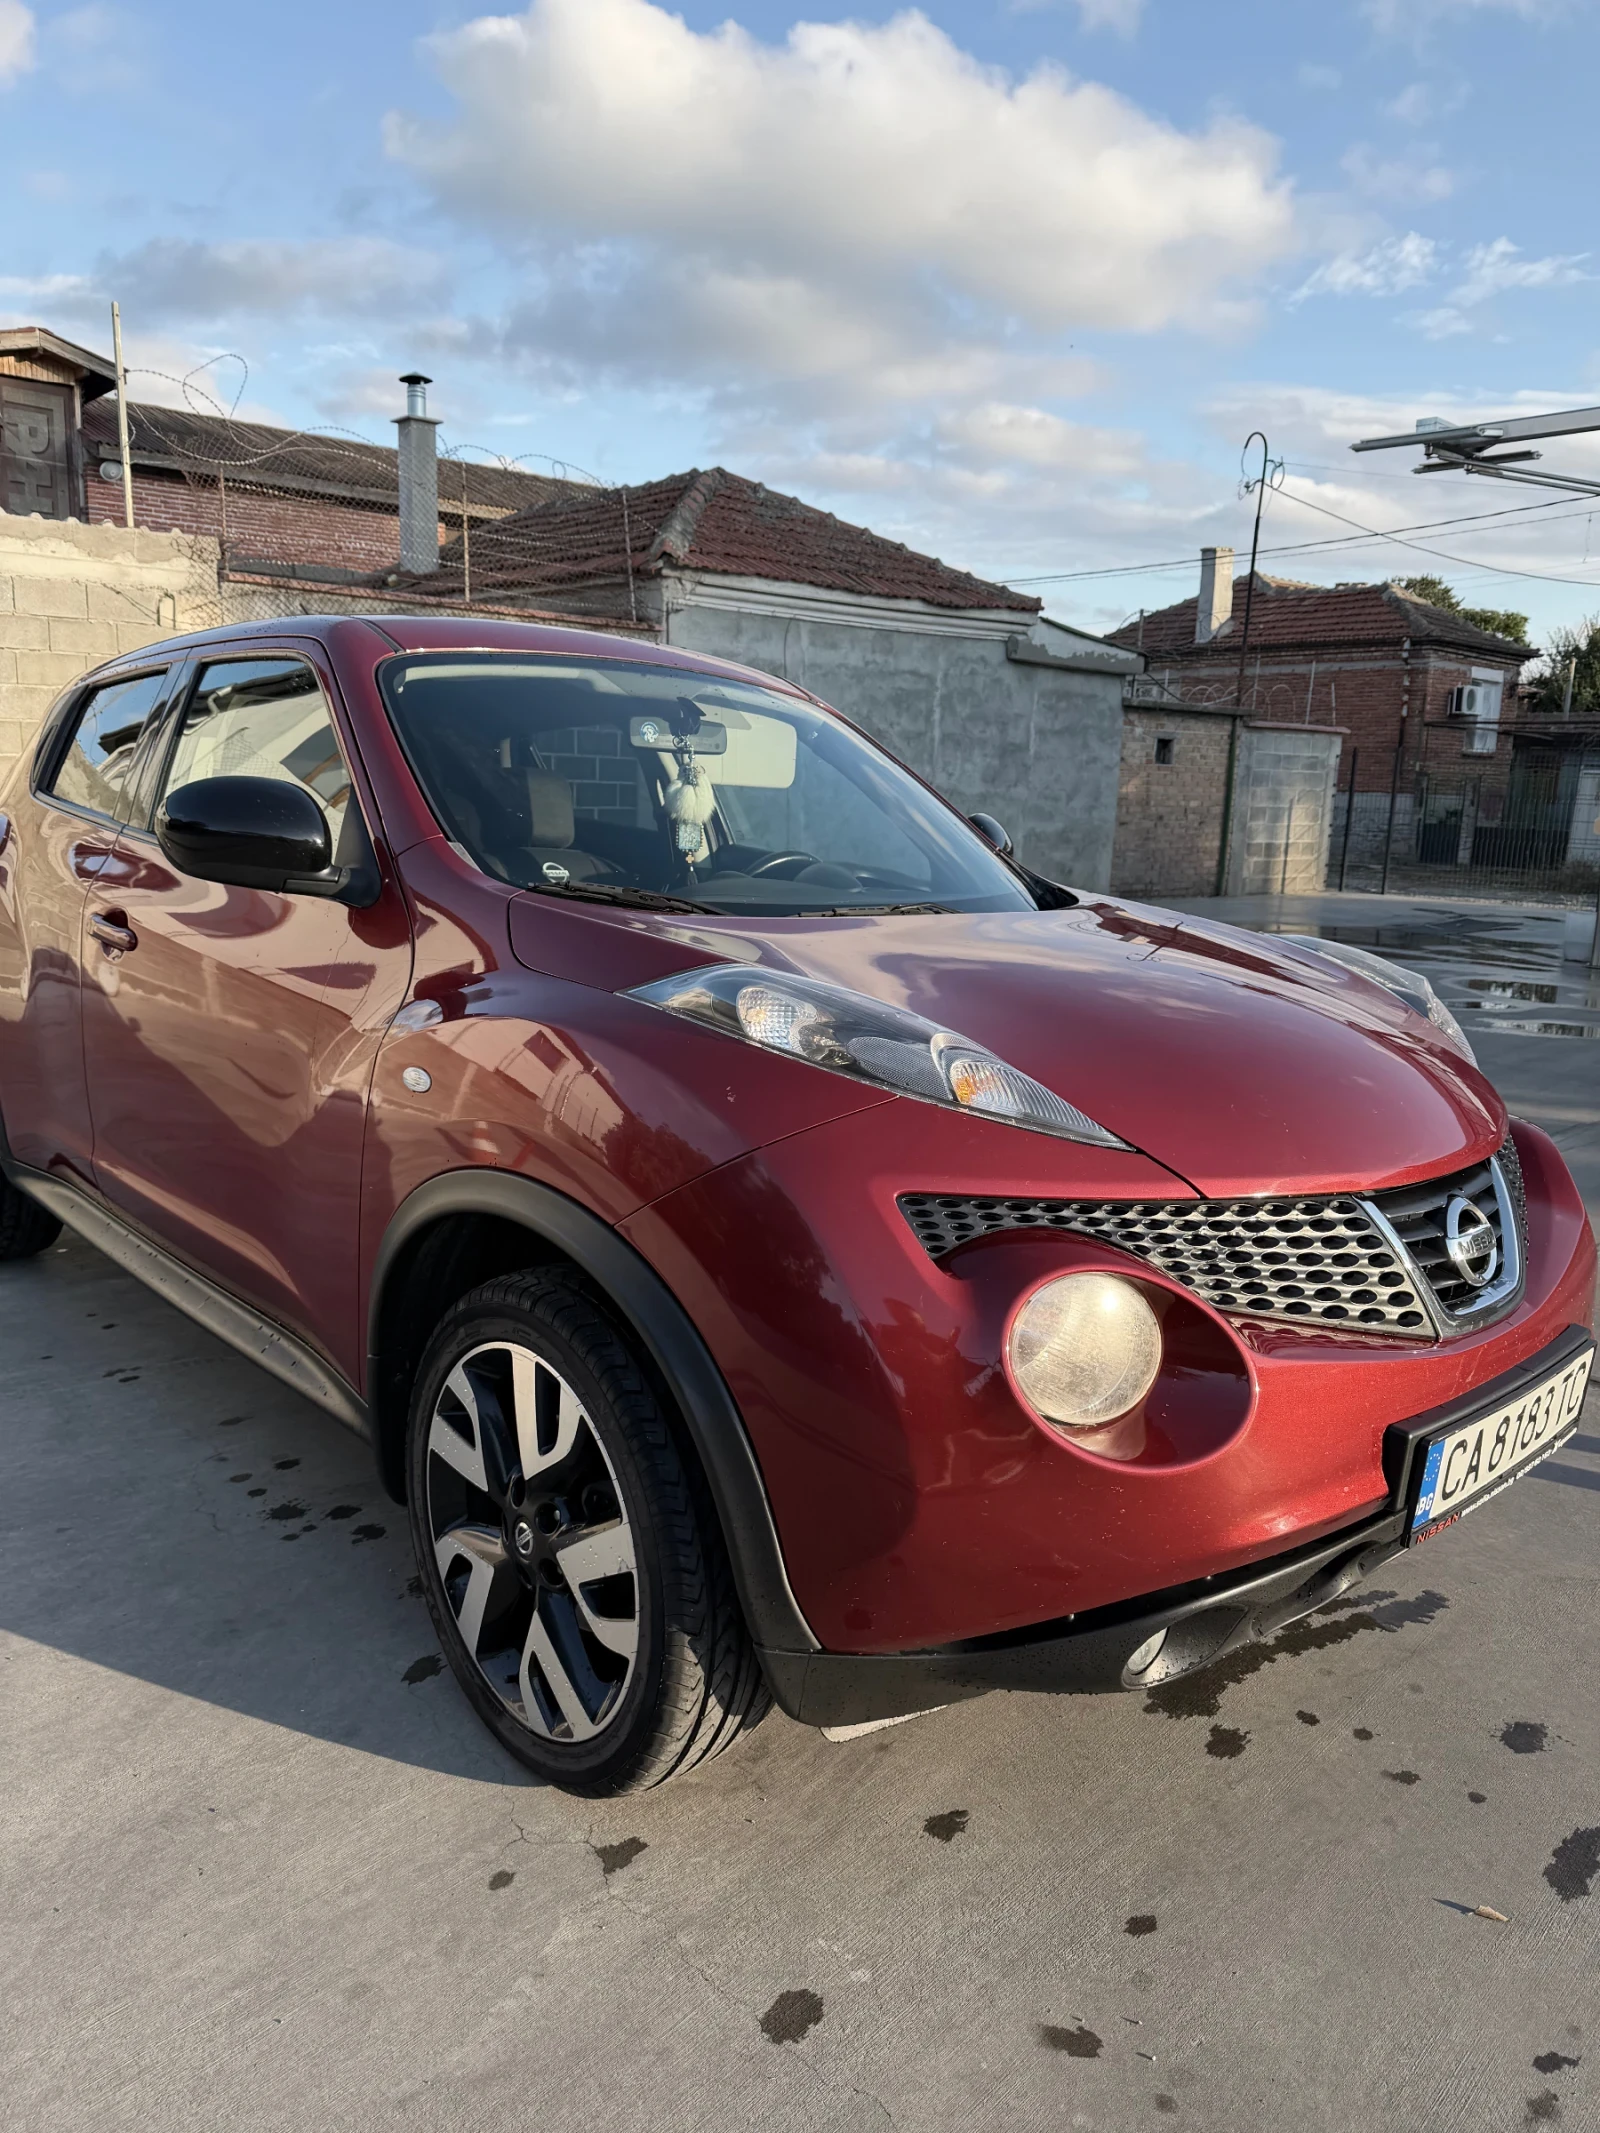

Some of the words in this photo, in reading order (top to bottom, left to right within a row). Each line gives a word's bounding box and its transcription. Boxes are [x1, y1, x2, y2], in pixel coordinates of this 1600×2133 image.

[1441, 1428, 1484, 1501] CA
[1488, 1385, 1556, 1473] 8183
[1556, 1360, 1587, 1426] TC
[1416, 1492, 1434, 1516] BG
[1416, 1511, 1460, 1545] NISSAN
